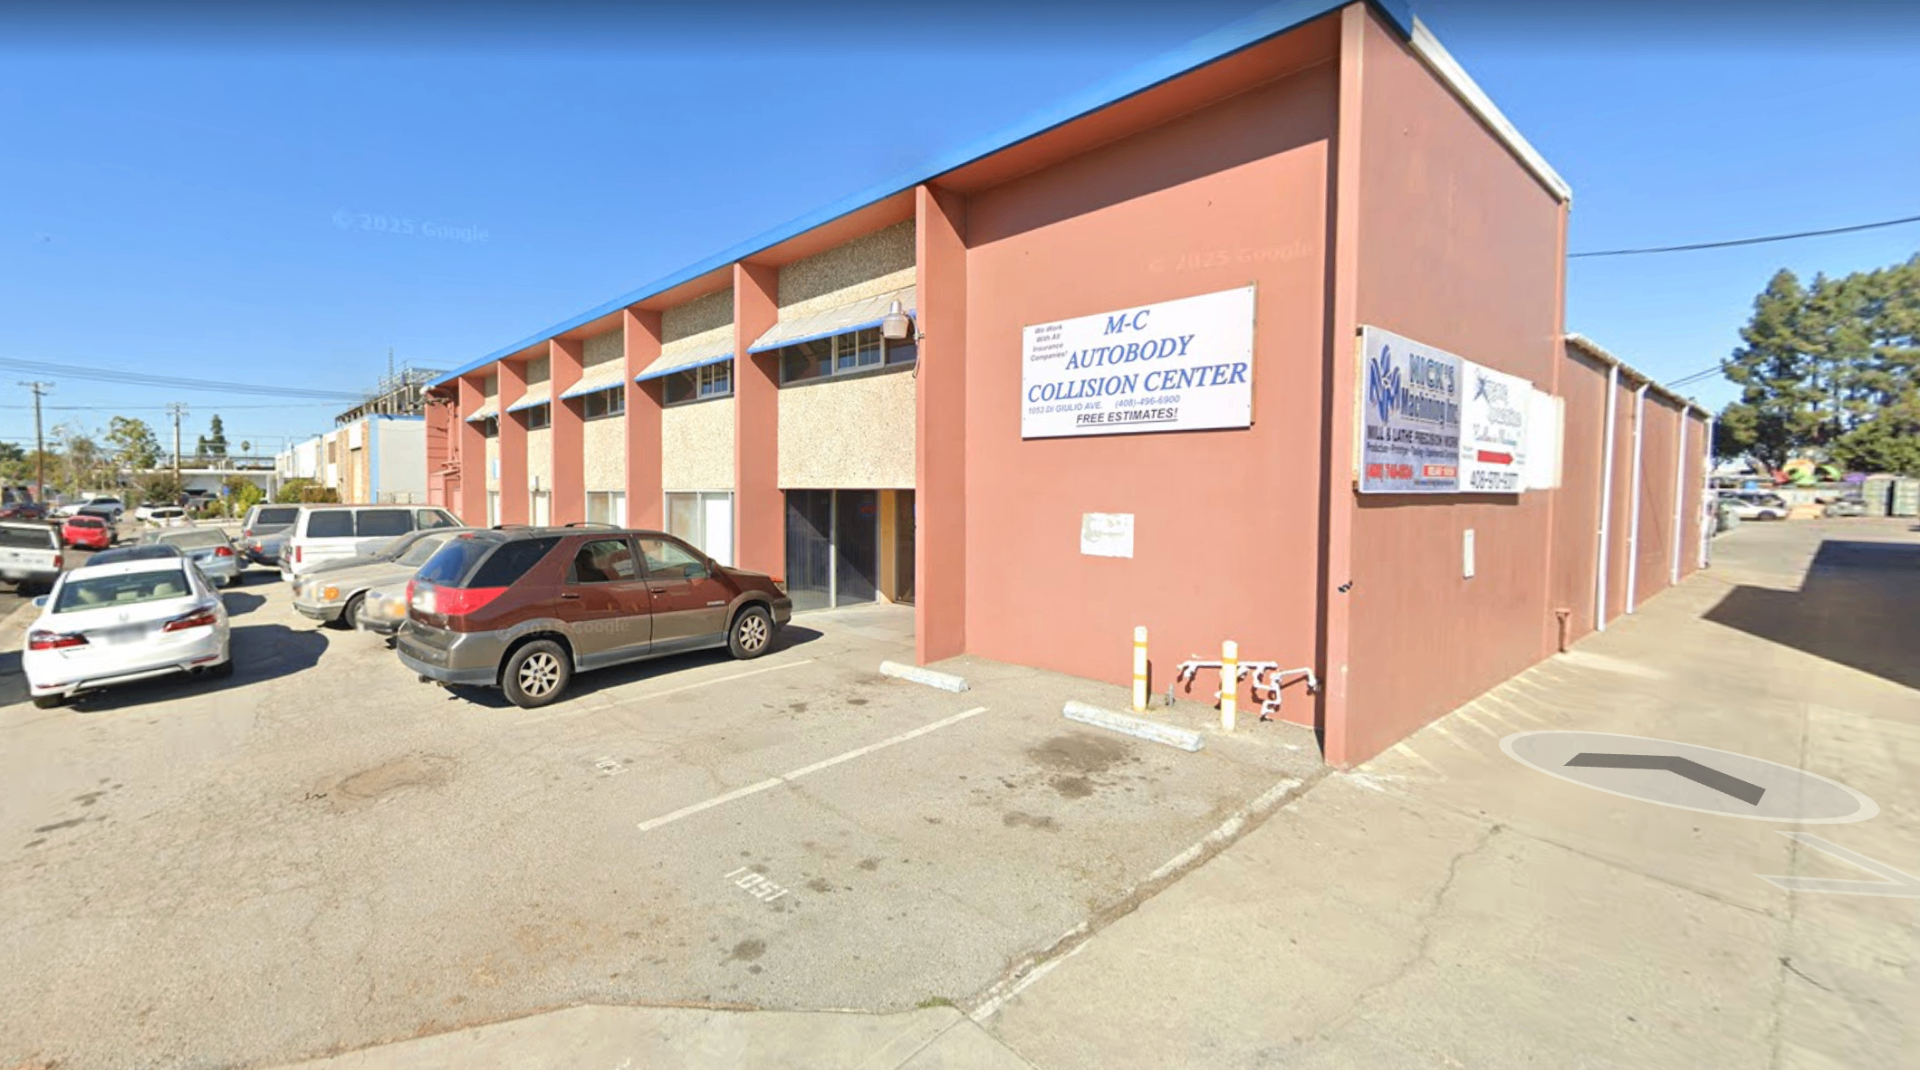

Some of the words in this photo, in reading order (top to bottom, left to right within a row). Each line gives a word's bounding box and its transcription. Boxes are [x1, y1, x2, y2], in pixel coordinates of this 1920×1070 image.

[1046, 324, 1063, 332] Work
[1103, 309, 1151, 336] M-C
[1032, 343, 1064, 352] Insurance
[1036, 335, 1051, 343] With
[1065, 334, 1195, 370] AUTOBODY
[1409, 352, 1455, 393] NICK'S
[1028, 374, 1140, 403] COLLISION
[1143, 362, 1248, 393] CENTER
[1028, 406, 1045, 415] 1053
[1055, 402, 1083, 413] GIULIO
[1076, 412, 1105, 424] FREE
[1107, 407, 1178, 423] ESTIMATES!
